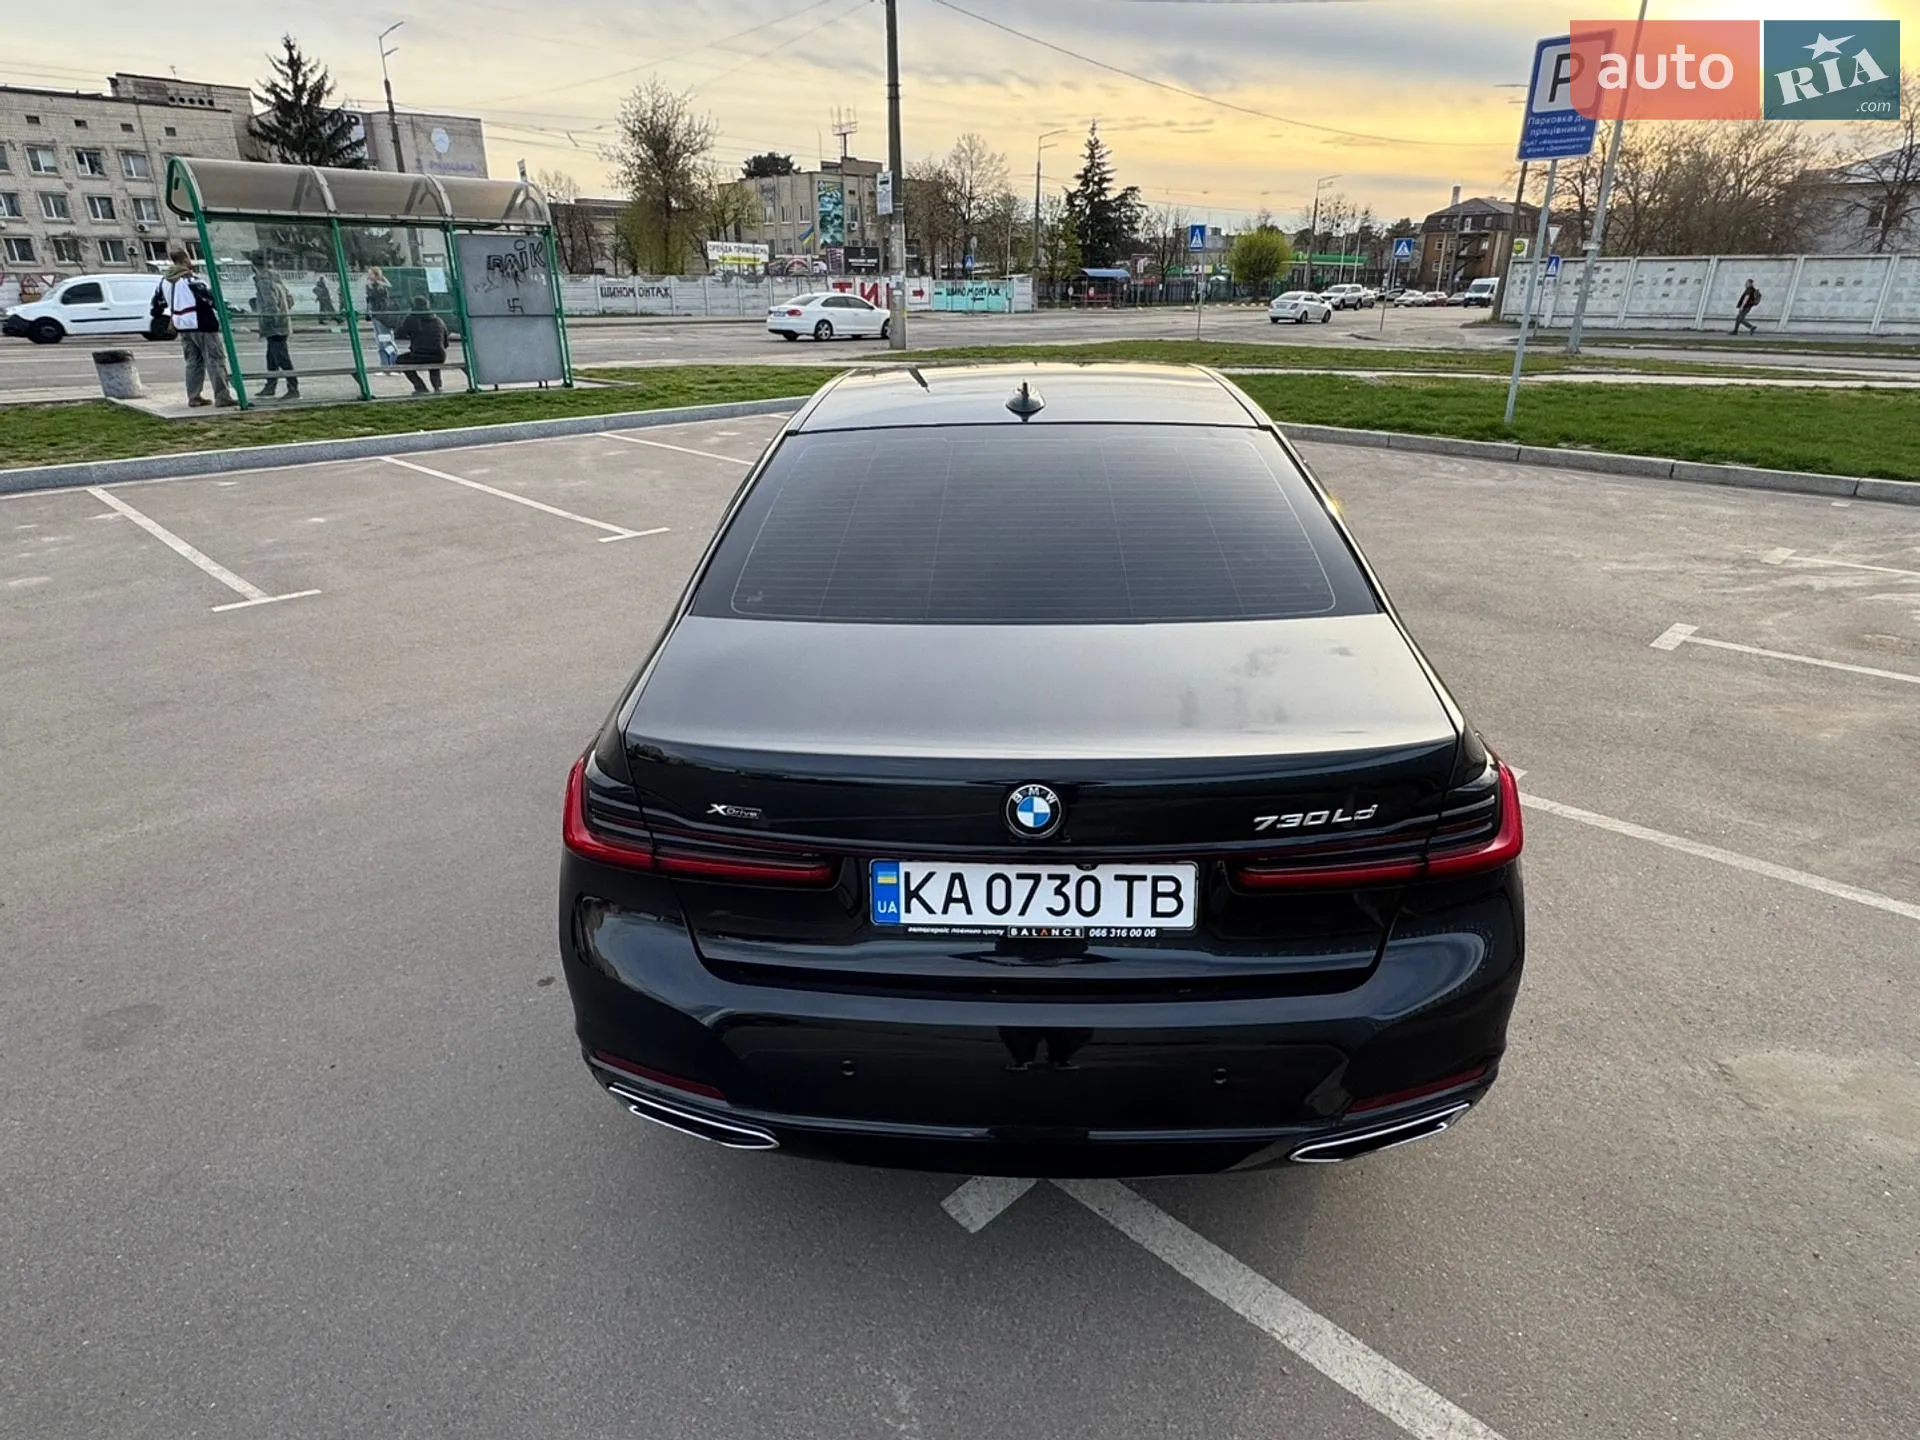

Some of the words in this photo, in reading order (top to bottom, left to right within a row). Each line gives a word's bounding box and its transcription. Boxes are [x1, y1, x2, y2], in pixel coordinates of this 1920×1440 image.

[1548, 51, 1585, 103] P
[1527, 115, 1573, 126] Парковка
[1011, 786, 1057, 804] BMW
[1253, 804, 1378, 831] 730Ld
[903, 871, 973, 916] KA
[986, 872, 1101, 918] 0730
[1113, 874, 1184, 919] TB
[877, 901, 897, 914] UA
[1010, 928, 1082, 936] BALANCE
[1089, 928, 1107, 937] 066
[1109, 928, 1127, 937] 316
[1129, 928, 1142, 937] 00
[1144, 928, 1157, 937] 06
